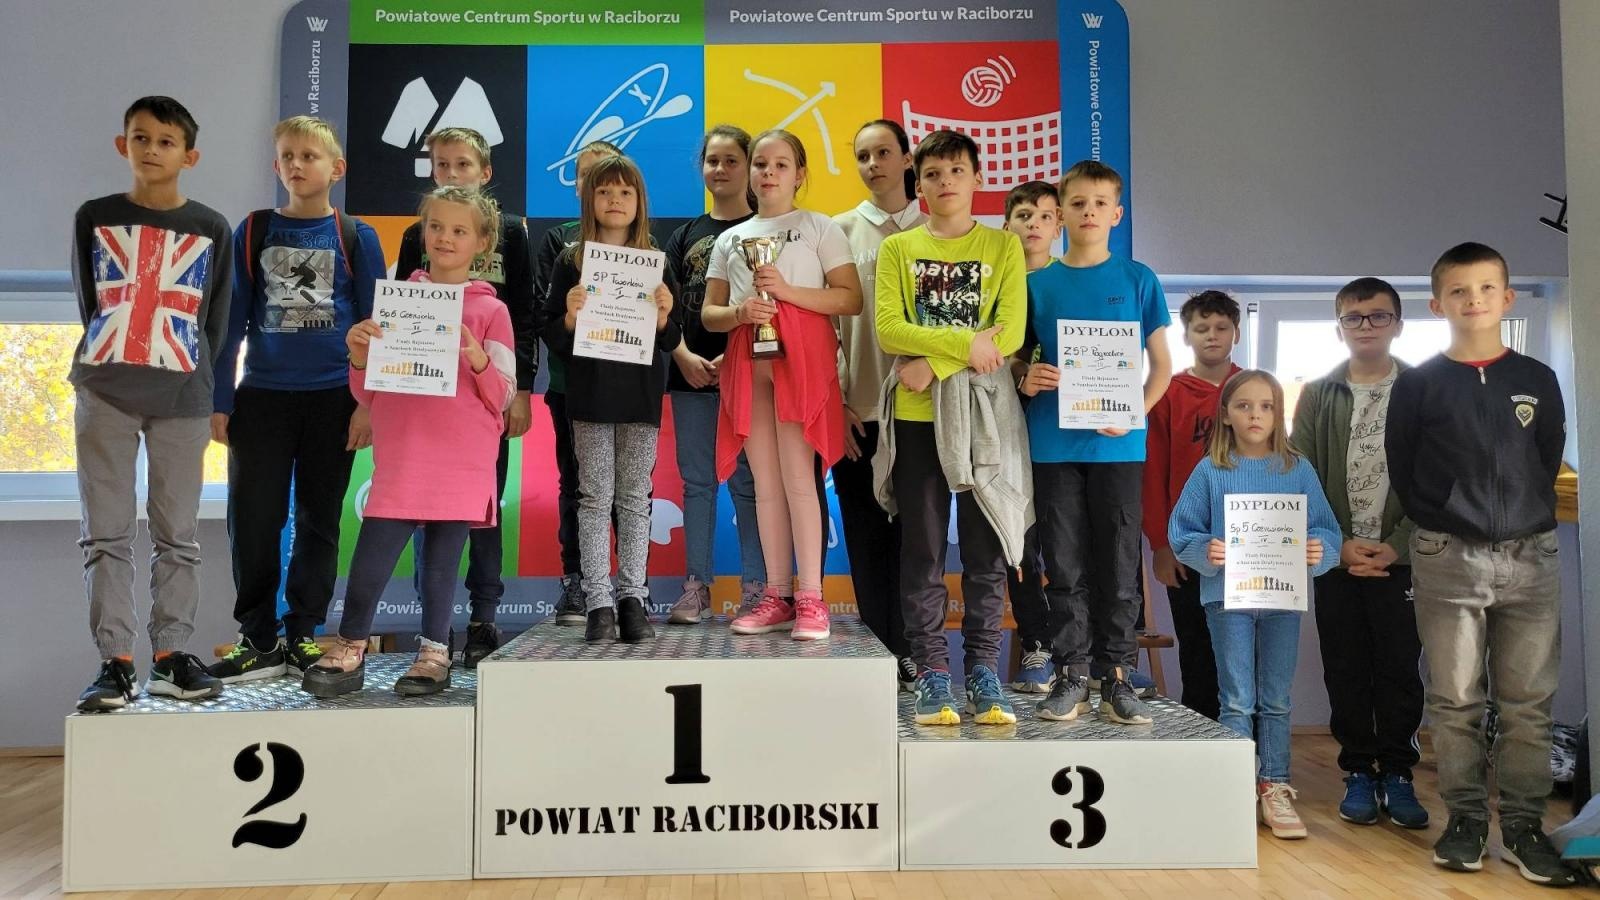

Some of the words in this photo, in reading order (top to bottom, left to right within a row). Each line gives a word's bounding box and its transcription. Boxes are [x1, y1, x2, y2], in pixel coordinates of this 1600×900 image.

[375, 9, 461, 23] Powiatowe
[463, 10, 531, 24] Centrum
[533, 10, 585, 26] Sportu
[587, 13, 602, 24] w
[604, 10, 681, 24] Raciborzu
[730, 9, 814, 23] Powiatowe
[816, 8, 884, 22] Centrum
[886, 7, 938, 23] Sportu
[940, 10, 954, 20] w
[957, 6, 1034, 20] Raciborzu
[307, 39, 321, 101] Raciborzu
[1088, 39, 1101, 109] Powiatowe
[590, 248, 660, 268] DYPLOM
[592, 271, 609, 282] SP
[382, 286, 457, 301] DYPLOM
[1063, 325, 1135, 337] DYPLOM
[1063, 345, 1089, 357] ZSP
[1230, 500, 1301, 511] DYPLOM
[664, 683, 711, 785] 1
[231, 741, 308, 850] 2
[1049, 765, 1107, 849] 3
[494, 806, 641, 837] POWIAT
[651, 802, 880, 834] RACIBORSKI
